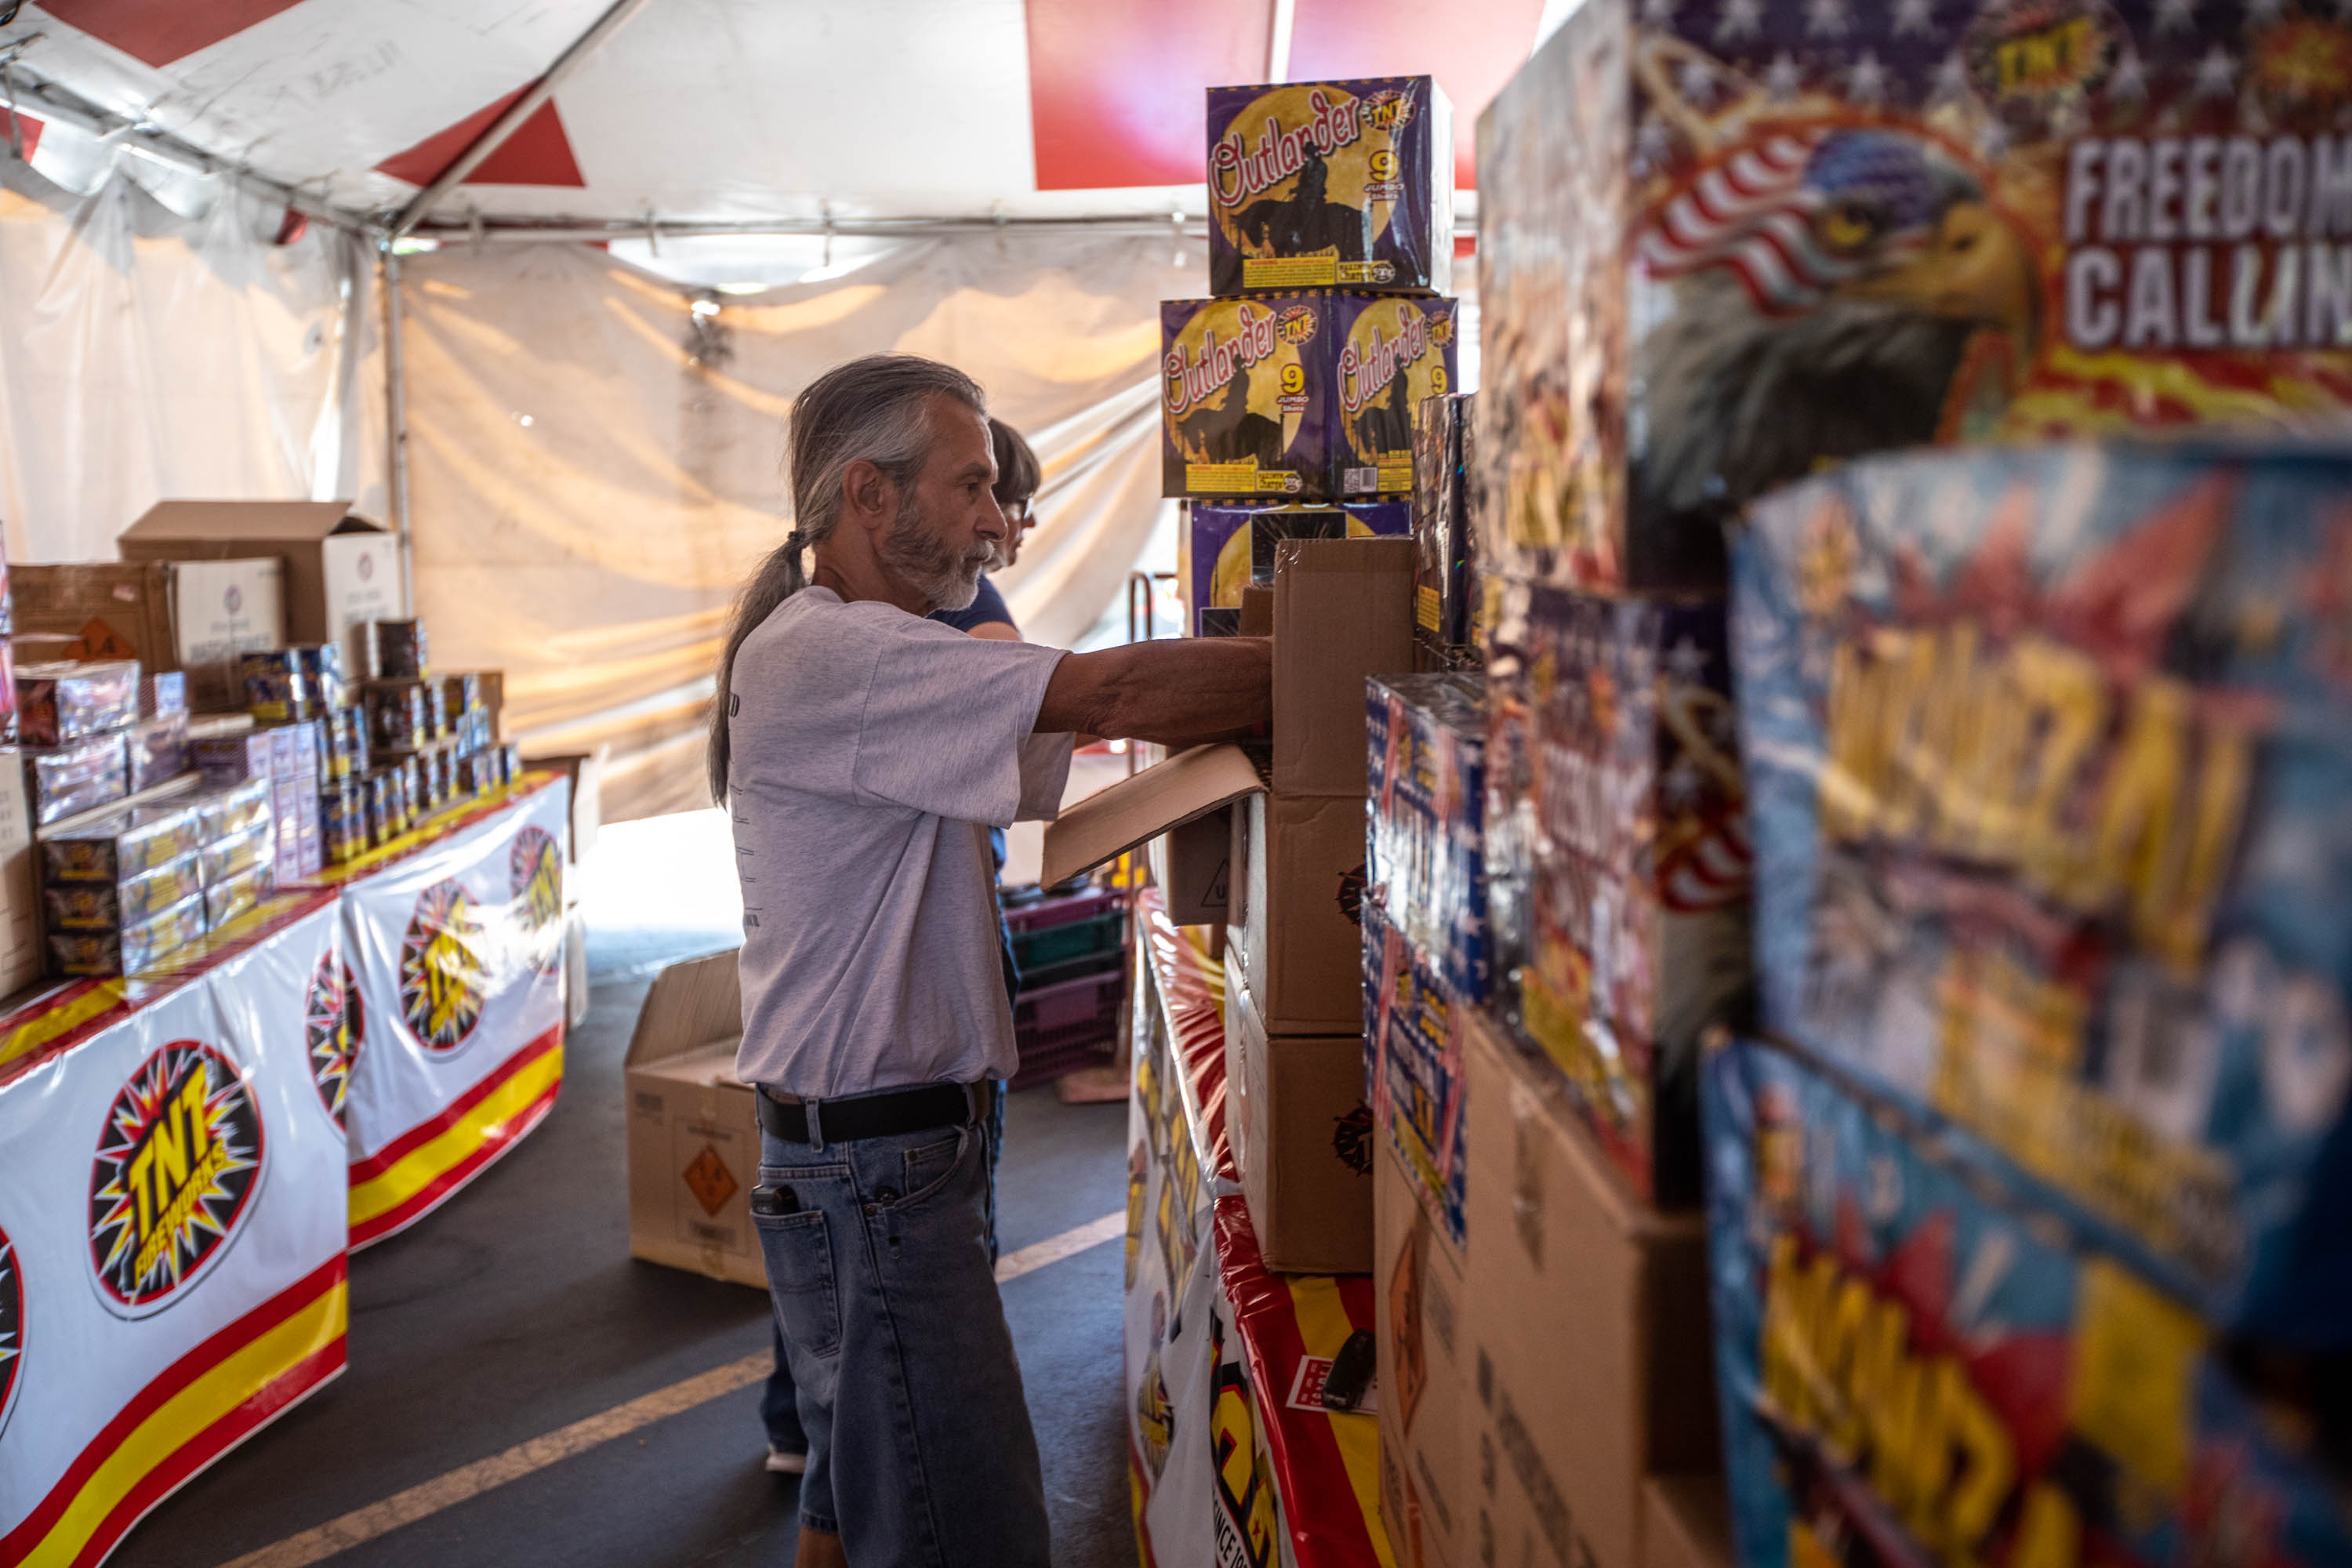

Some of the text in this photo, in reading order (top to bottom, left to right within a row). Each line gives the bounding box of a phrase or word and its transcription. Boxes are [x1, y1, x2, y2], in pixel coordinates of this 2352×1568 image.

[1372, 99, 1403, 125] TNT
[1209, 89, 1360, 207] Outlander
[1369, 150, 1400, 182] 9
[1163, 303, 1276, 414] Outlander
[1284, 314, 1311, 340] TNT
[1337, 304, 1426, 412] Outlander
[1279, 363, 1305, 394] 9
[1430, 365, 1448, 394] 9
[129, 1061, 209, 1247] TNT
[134, 1137, 227, 1290] FIREWORKS
